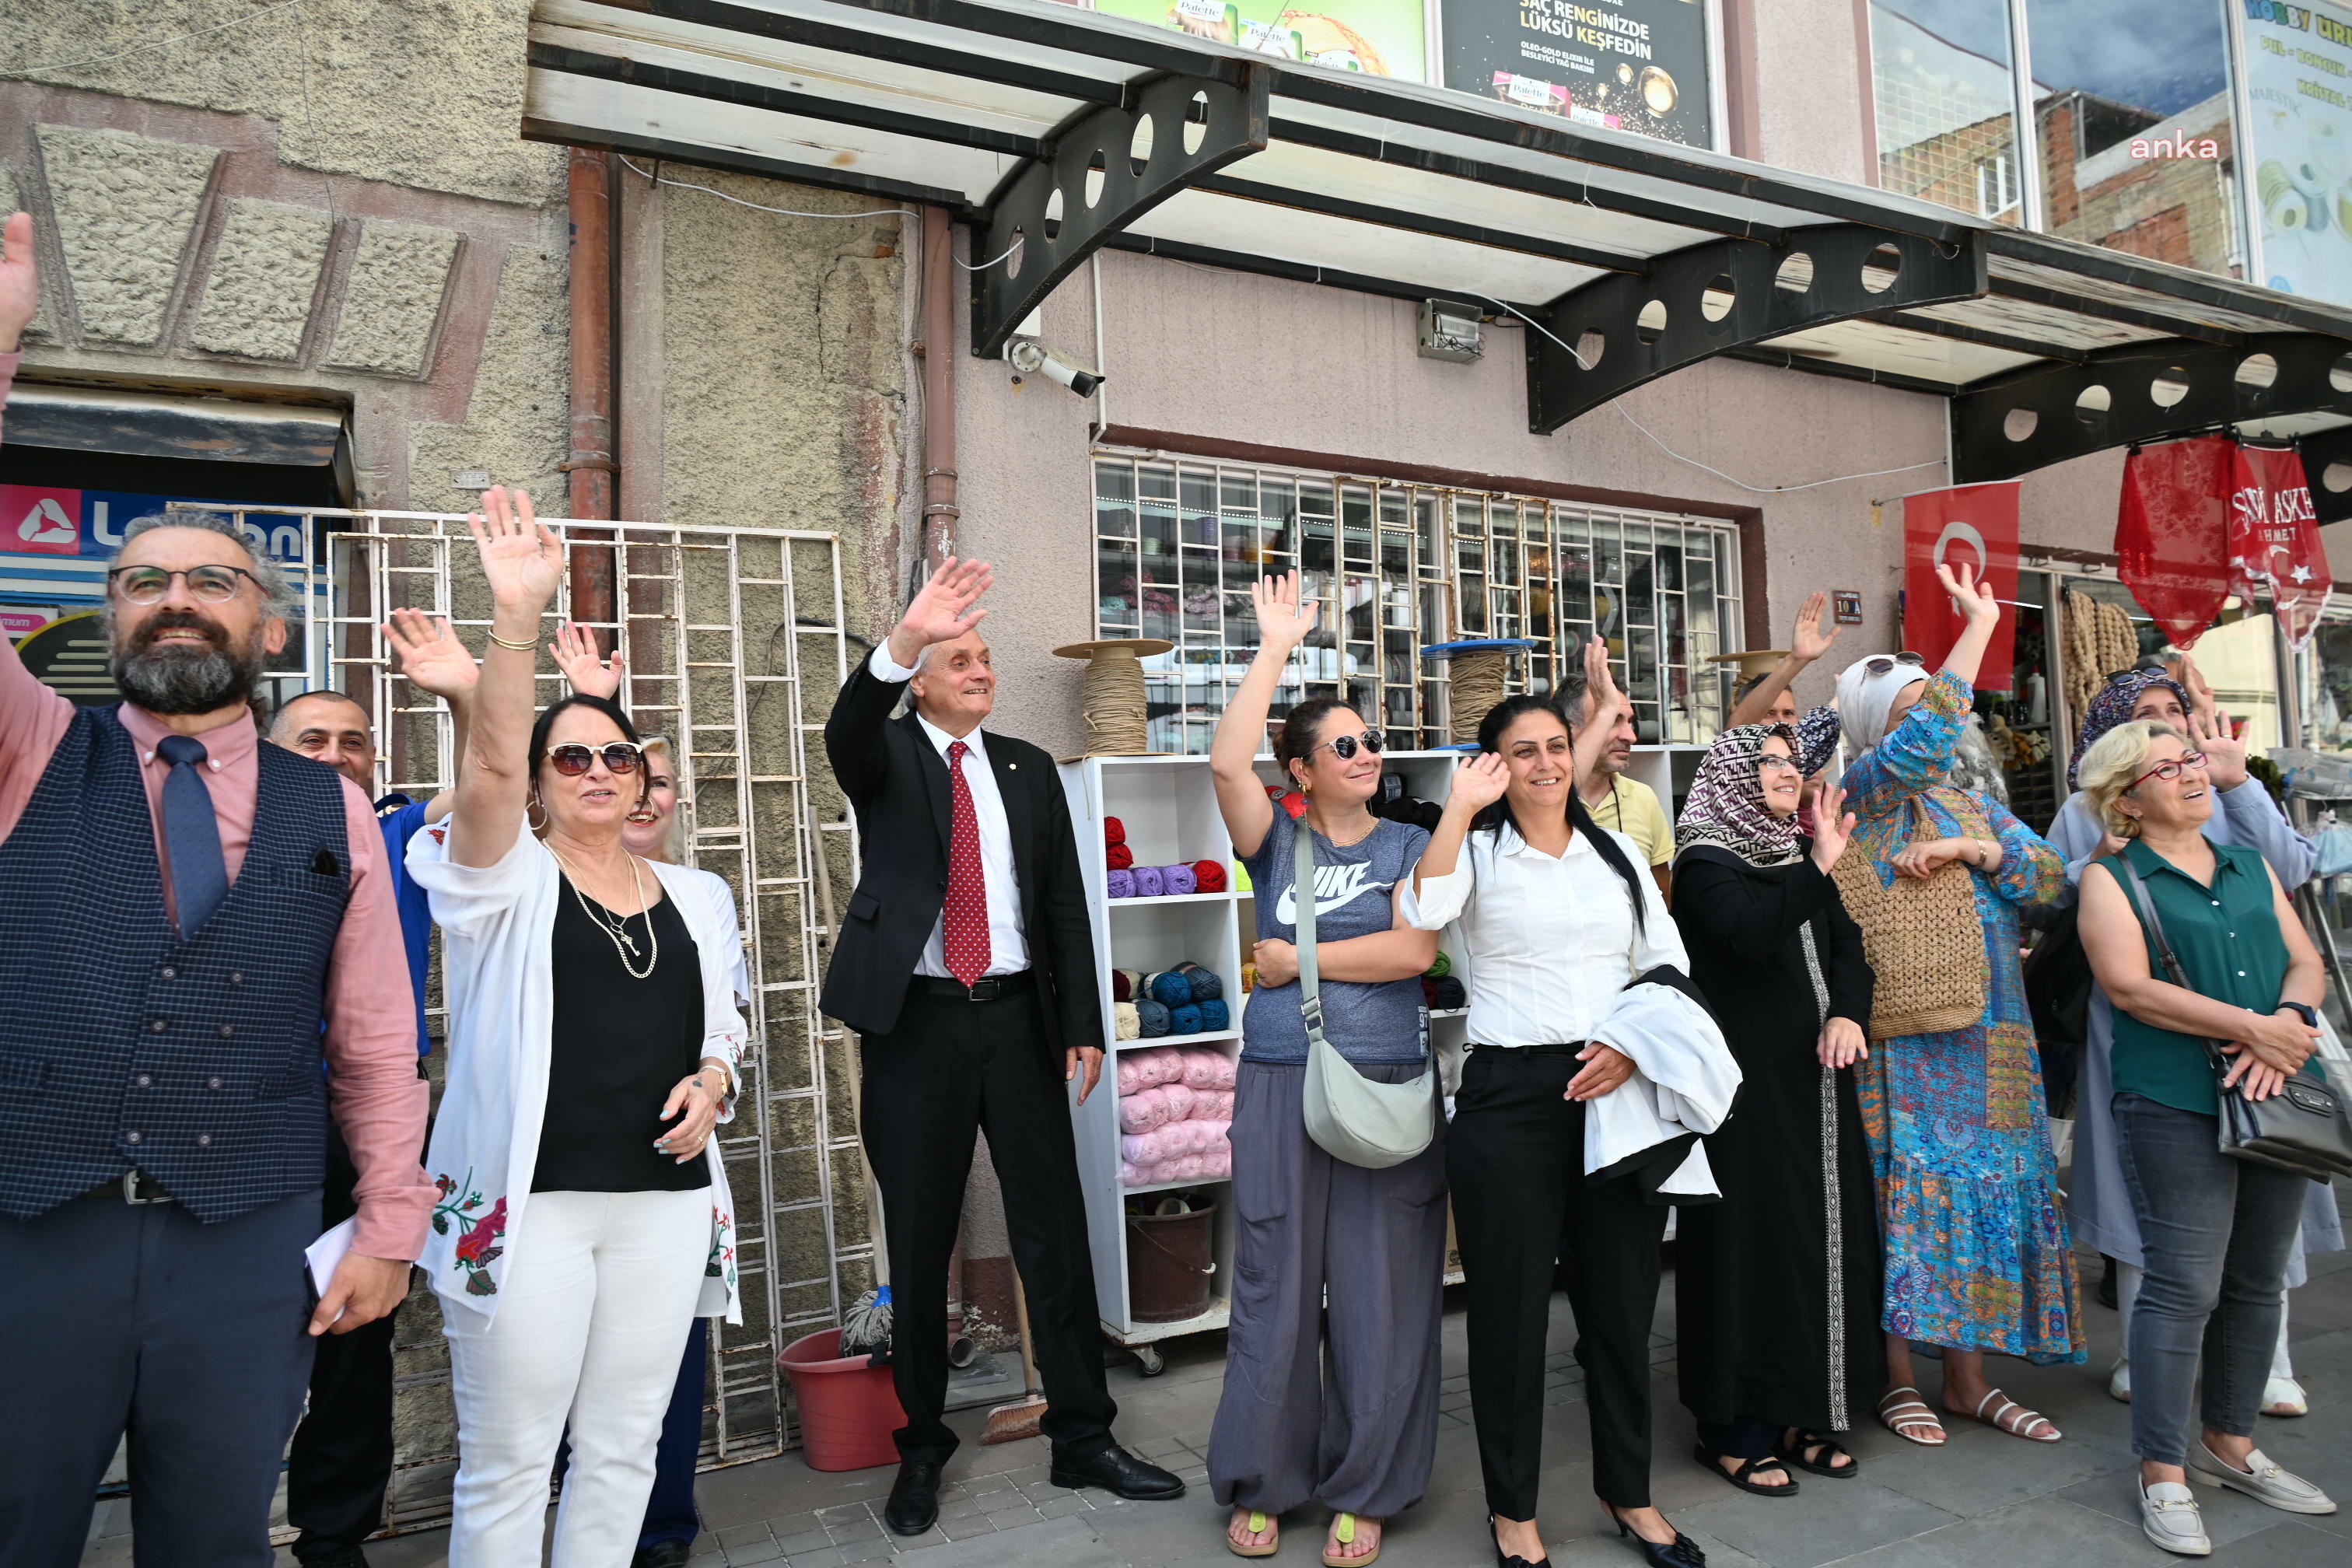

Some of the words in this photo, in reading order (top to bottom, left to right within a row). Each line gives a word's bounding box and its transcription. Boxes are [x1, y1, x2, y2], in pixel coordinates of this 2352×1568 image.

[1181, 2, 1219, 16] Palette
[2245, 0, 2311, 32] HOBBY
[1554, 1, 1650, 40] RENGİNİZDE
[1520, 11, 1573, 39] LÜKSÜ
[1577, 26, 1652, 61] KEŞFEDİN
[1521, 41, 1561, 58] OLEO-GOLD
[1521, 49, 1556, 65] BESLEYİCİ
[1556, 56, 1570, 68] YAĞ
[1570, 60, 1594, 75] BAKIMI
[2258, 527, 2296, 541] AHMET
[1836, 600, 1850, 613] 10
